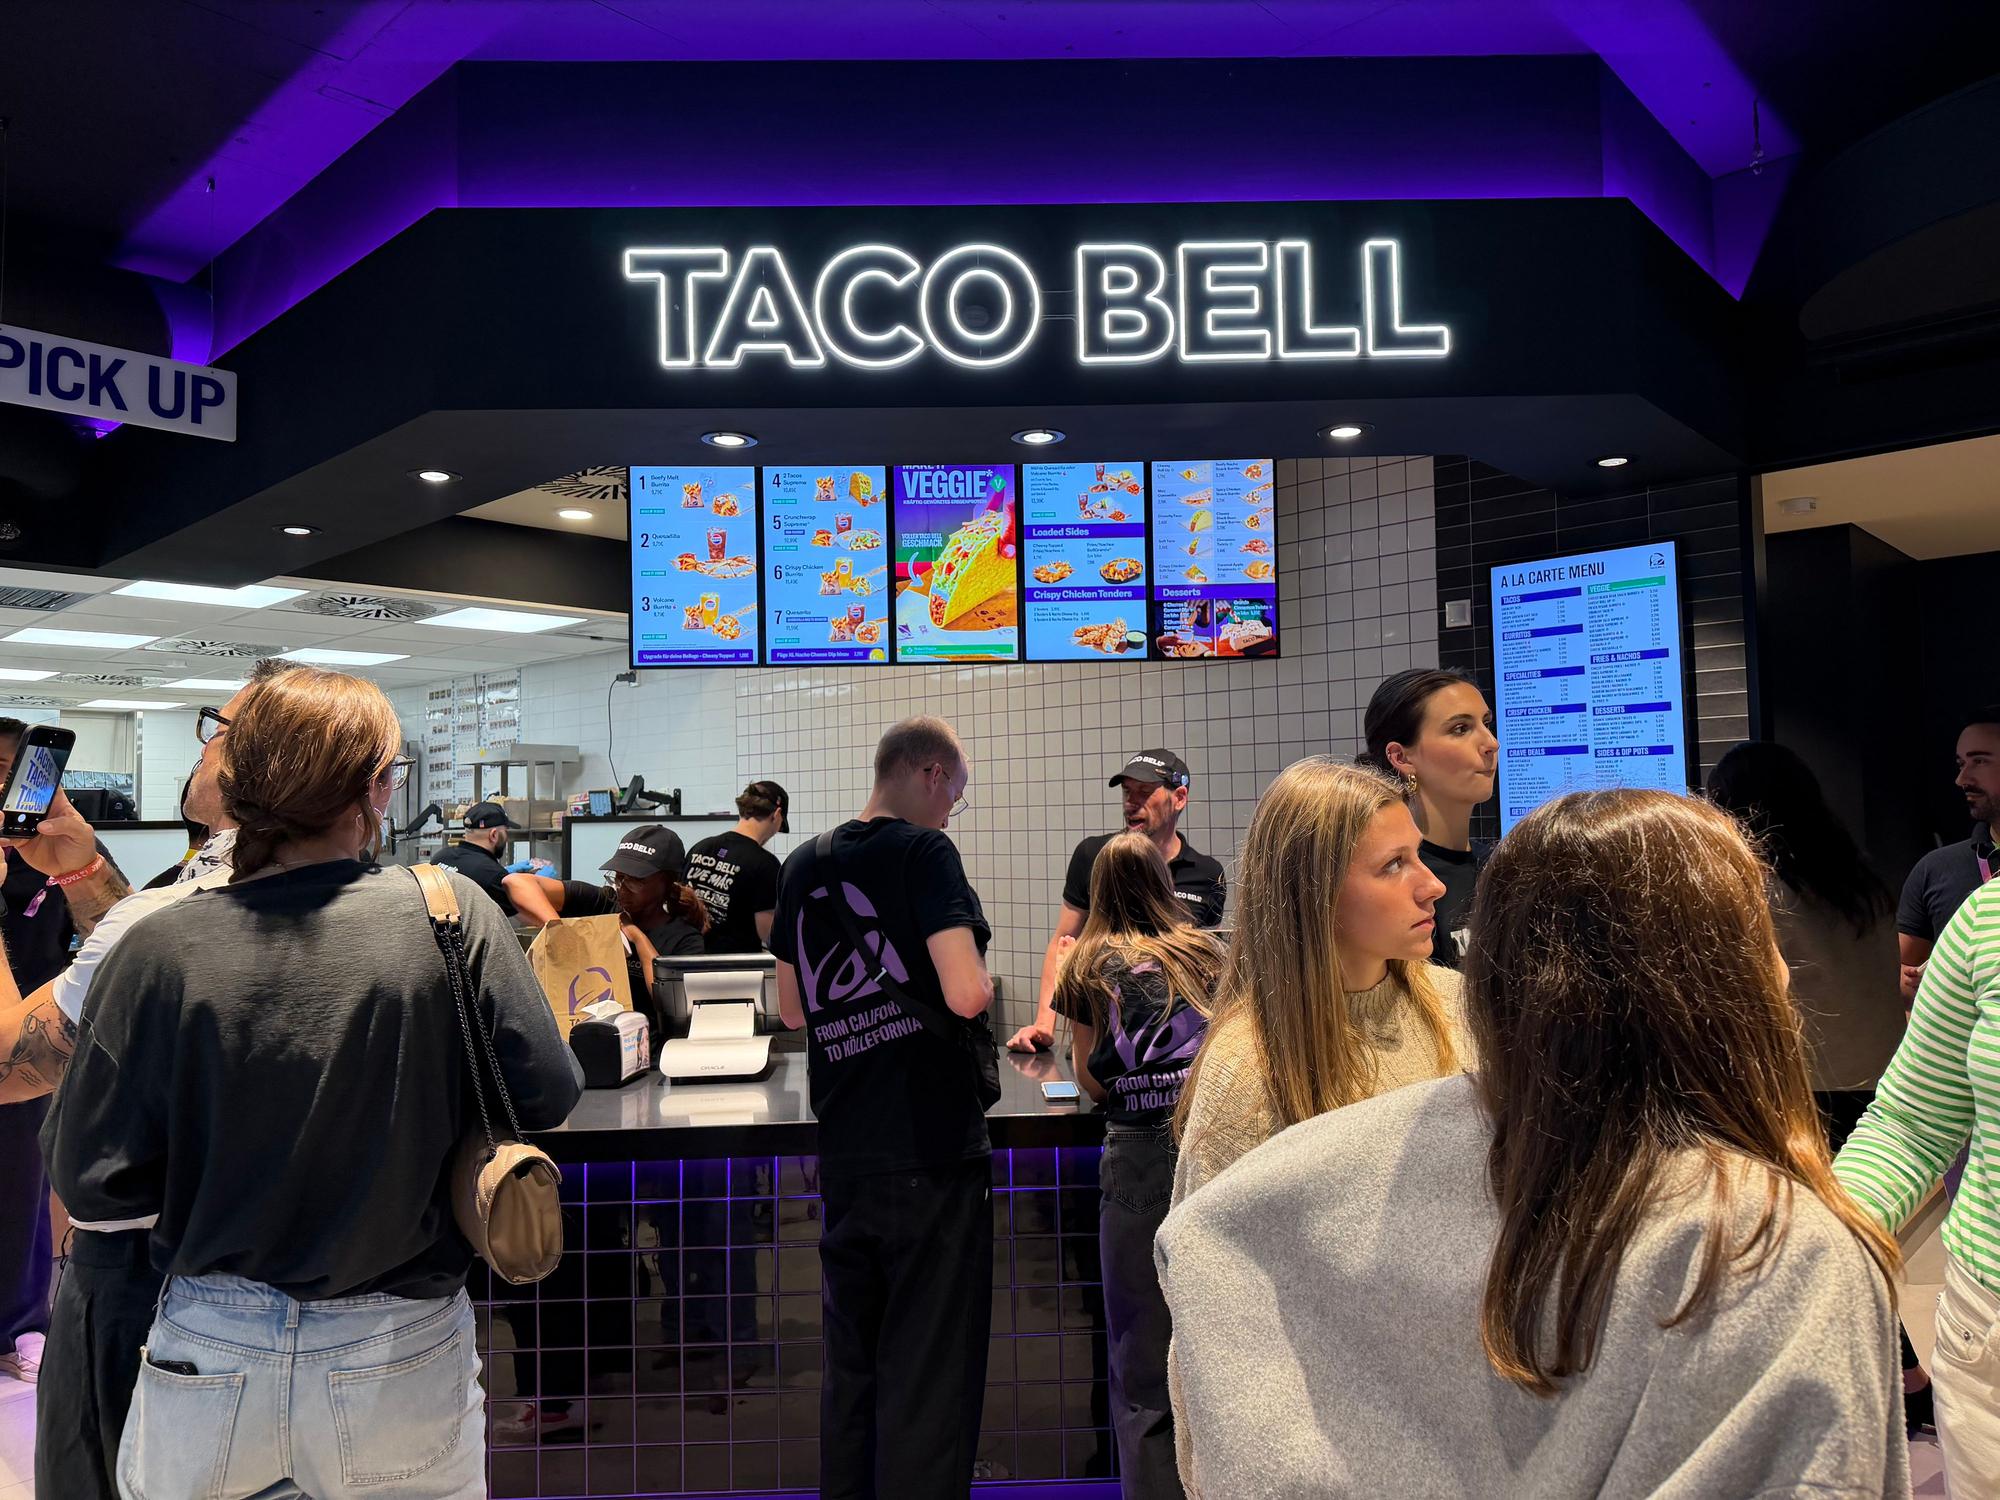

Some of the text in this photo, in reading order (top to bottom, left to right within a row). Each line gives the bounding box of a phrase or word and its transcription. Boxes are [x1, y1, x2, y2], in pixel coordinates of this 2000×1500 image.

[623, 238, 1451, 369] TACO BELL
[0, 335, 225, 424] PICK UP
[640, 475, 645, 490] 1
[773, 473, 781, 488] 4
[773, 515, 781, 530] 5
[1032, 527, 1089, 536] Loaded Sides
[641, 533, 649, 548] 2
[774, 564, 782, 580] 6
[1501, 561, 1605, 588] A LA CARTE MENU
[1033, 589, 1132, 600] Crispy Chicken Tenders
[1162, 588, 1201, 597] Desserts
[642, 596, 650, 612] 3
[774, 610, 782, 624] 7
[1616, 651, 1640, 660] NACHOS
[1505, 670, 1541, 680] SPECIALITIES
[1507, 706, 1552, 716] CRISPY CHICKEN
[1594, 706, 1625, 715] DESSERTS
[1596, 749, 1614, 757] SIDES
[1621, 748, 1632, 756] DIP
[1632, 747, 1649, 755] POTS
[690, 853, 717, 867] TACO
[707, 873, 734, 890] MÁS
[814, 1018, 849, 1043] FROM
[824, 1017, 924, 1063] TO KÖLLEFORNIA
[1115, 1067, 1190, 1094] FROM CALIF
[1124, 1088, 1180, 1112] TO KÖLLE
